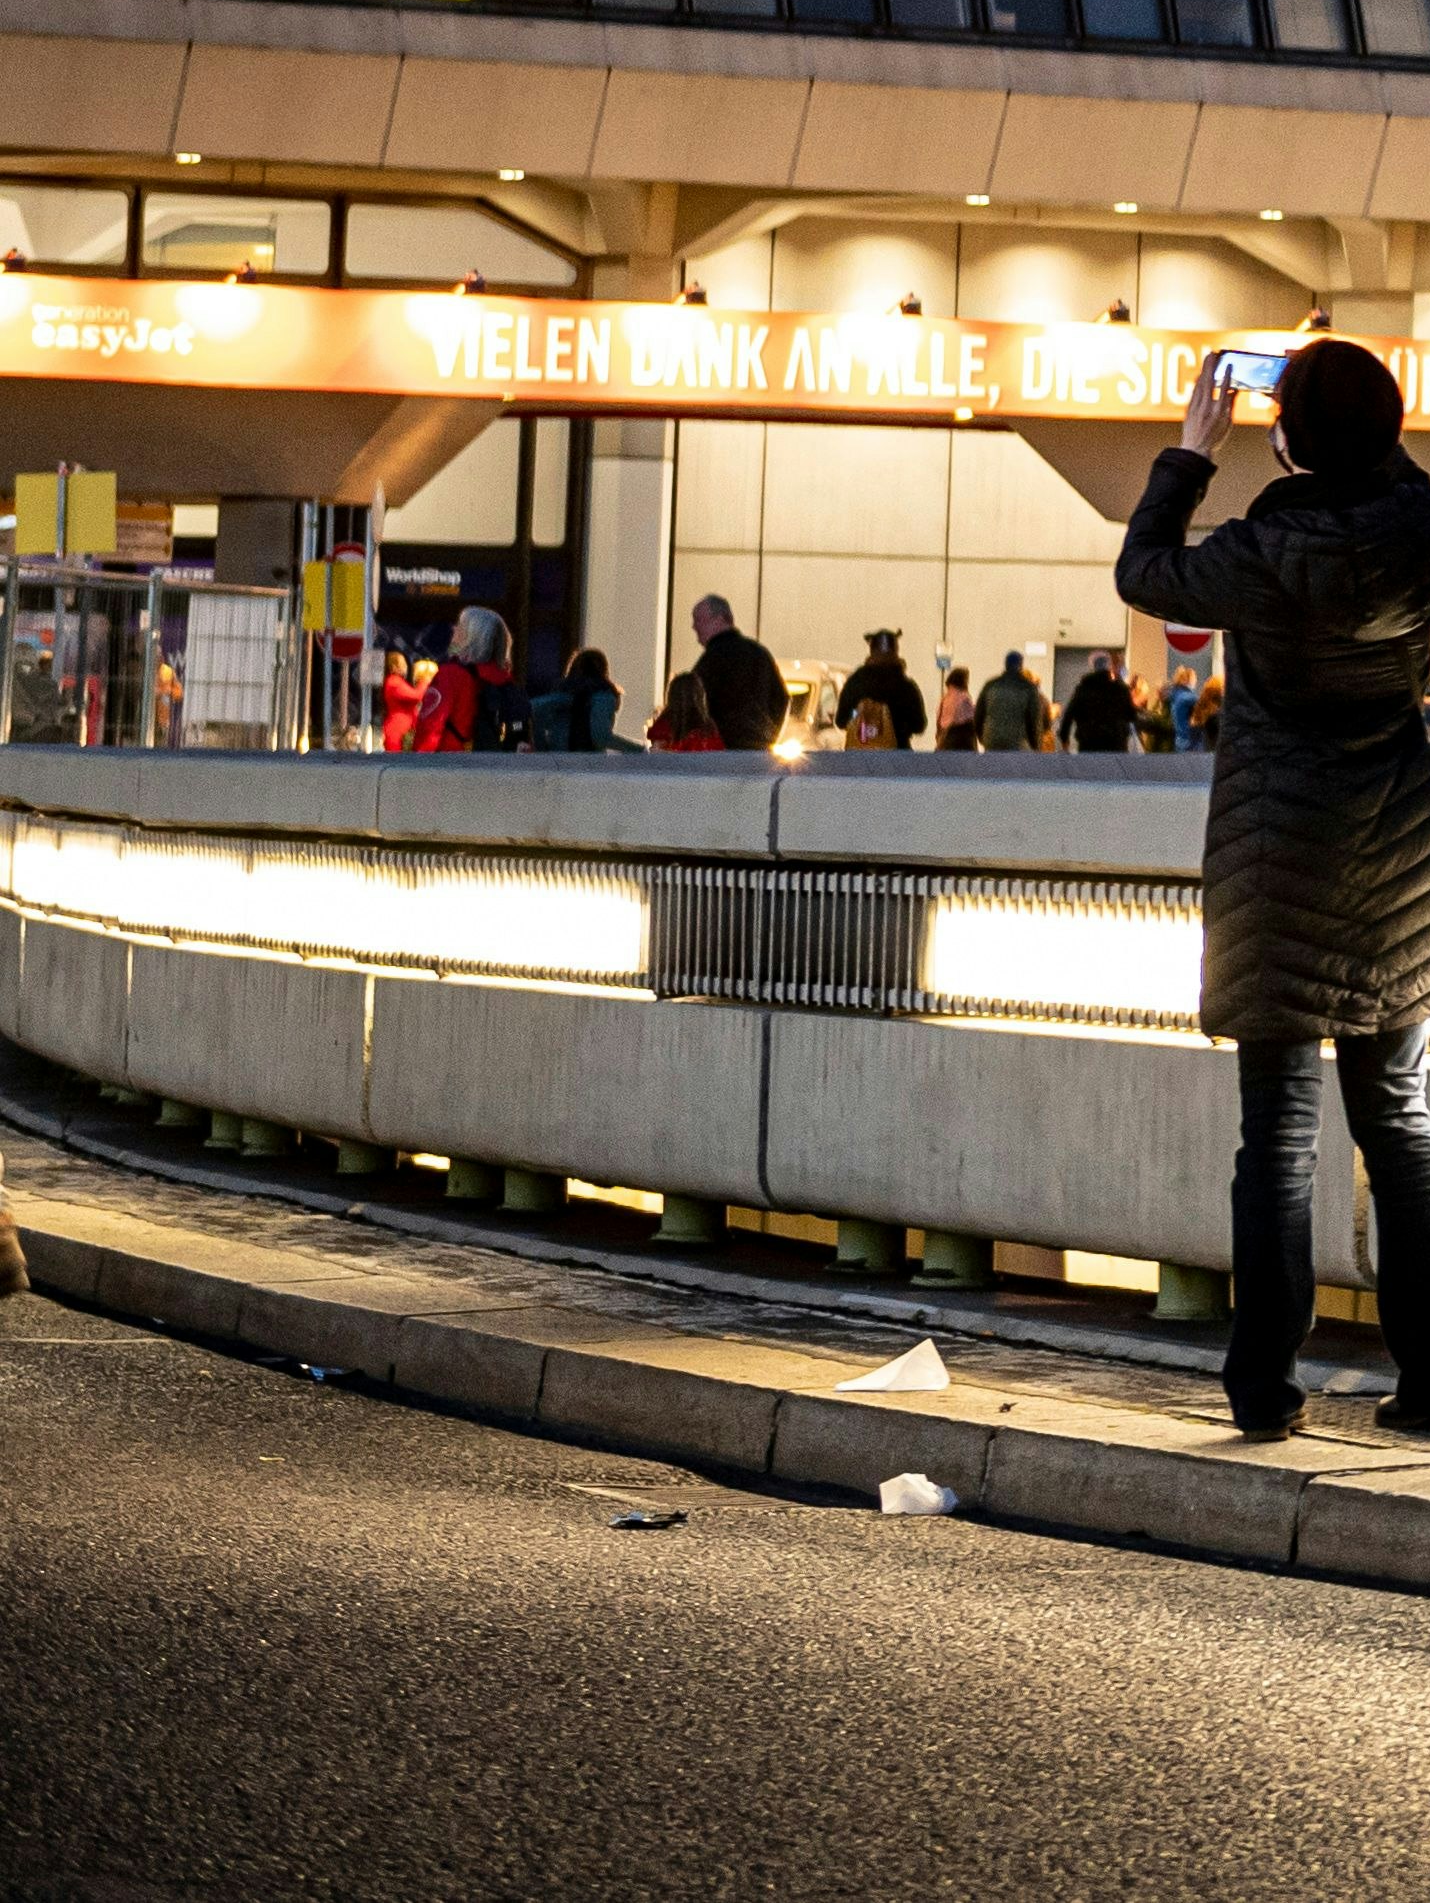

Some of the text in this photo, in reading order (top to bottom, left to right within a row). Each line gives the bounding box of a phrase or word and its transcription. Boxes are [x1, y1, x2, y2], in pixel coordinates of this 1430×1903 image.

[32, 318, 194, 358] easyJet
[430, 310, 611, 382] VIELEN
[630, 317, 768, 388] DANK
[784, 327, 851, 393] AN
[866, 331, 999, 406] ALLE,
[1021, 334, 1100, 404] DIE
[1117, 339, 1209, 404] SIC
